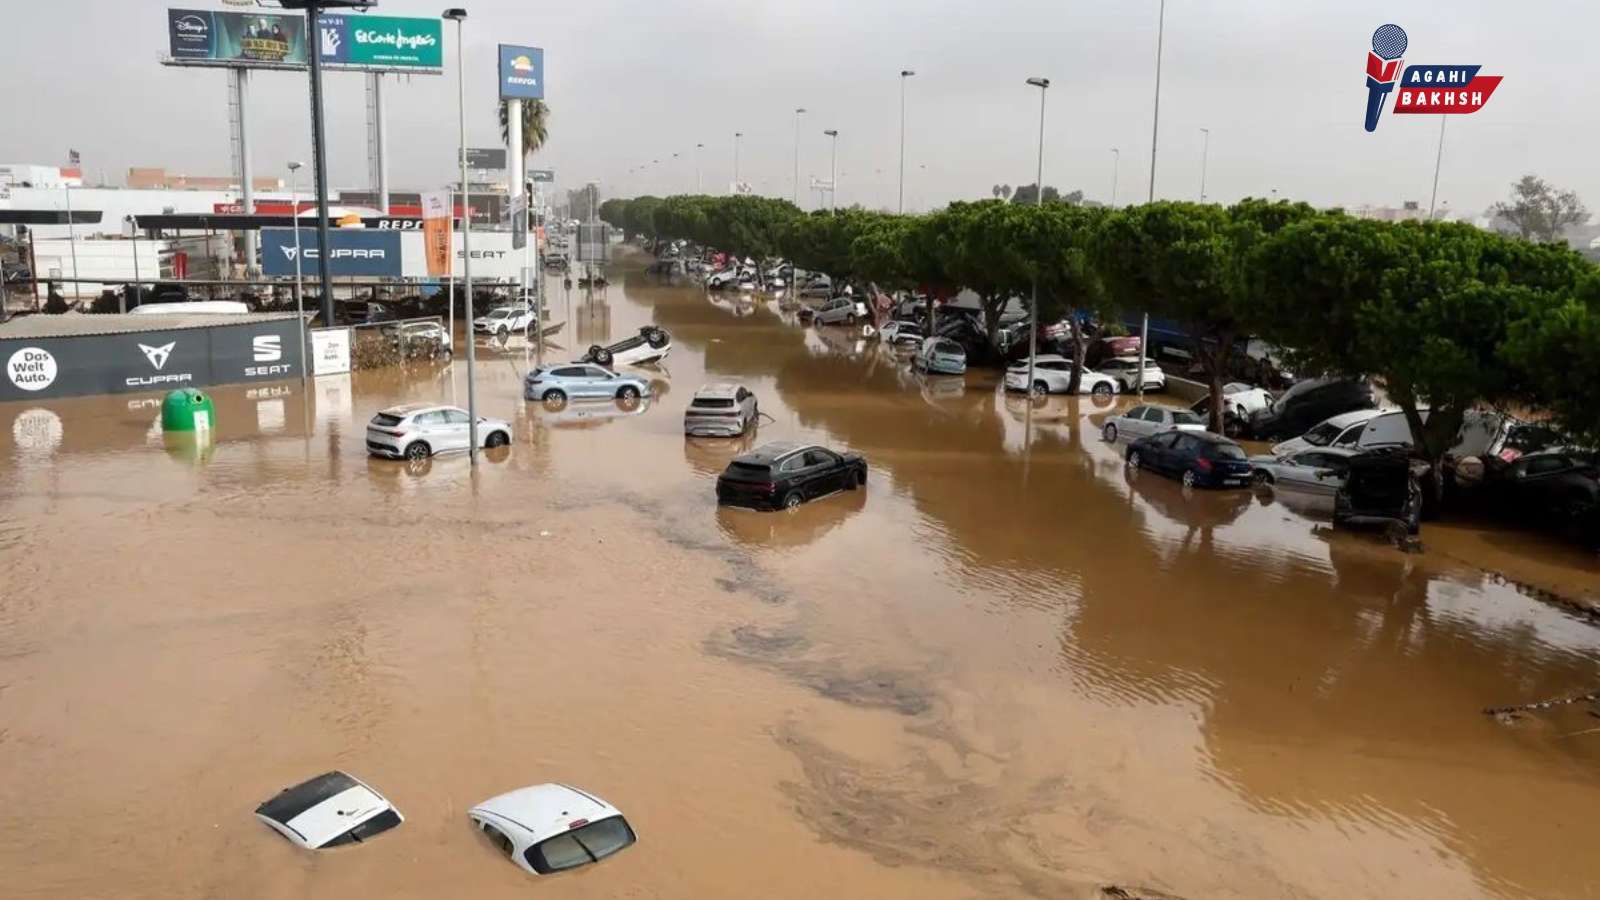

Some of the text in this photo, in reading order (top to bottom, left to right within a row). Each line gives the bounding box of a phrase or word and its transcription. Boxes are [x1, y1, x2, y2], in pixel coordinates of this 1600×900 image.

[355, 30, 368, 43] El
[367, 30, 396, 44] Corte
[457, 250, 506, 259] SEAT
[24, 352, 49, 362] Das
[13, 362, 44, 373] Welt
[245, 364, 291, 377] SEAT
[15, 373, 50, 384] Auto.
[126, 373, 192, 386] CUPRA
